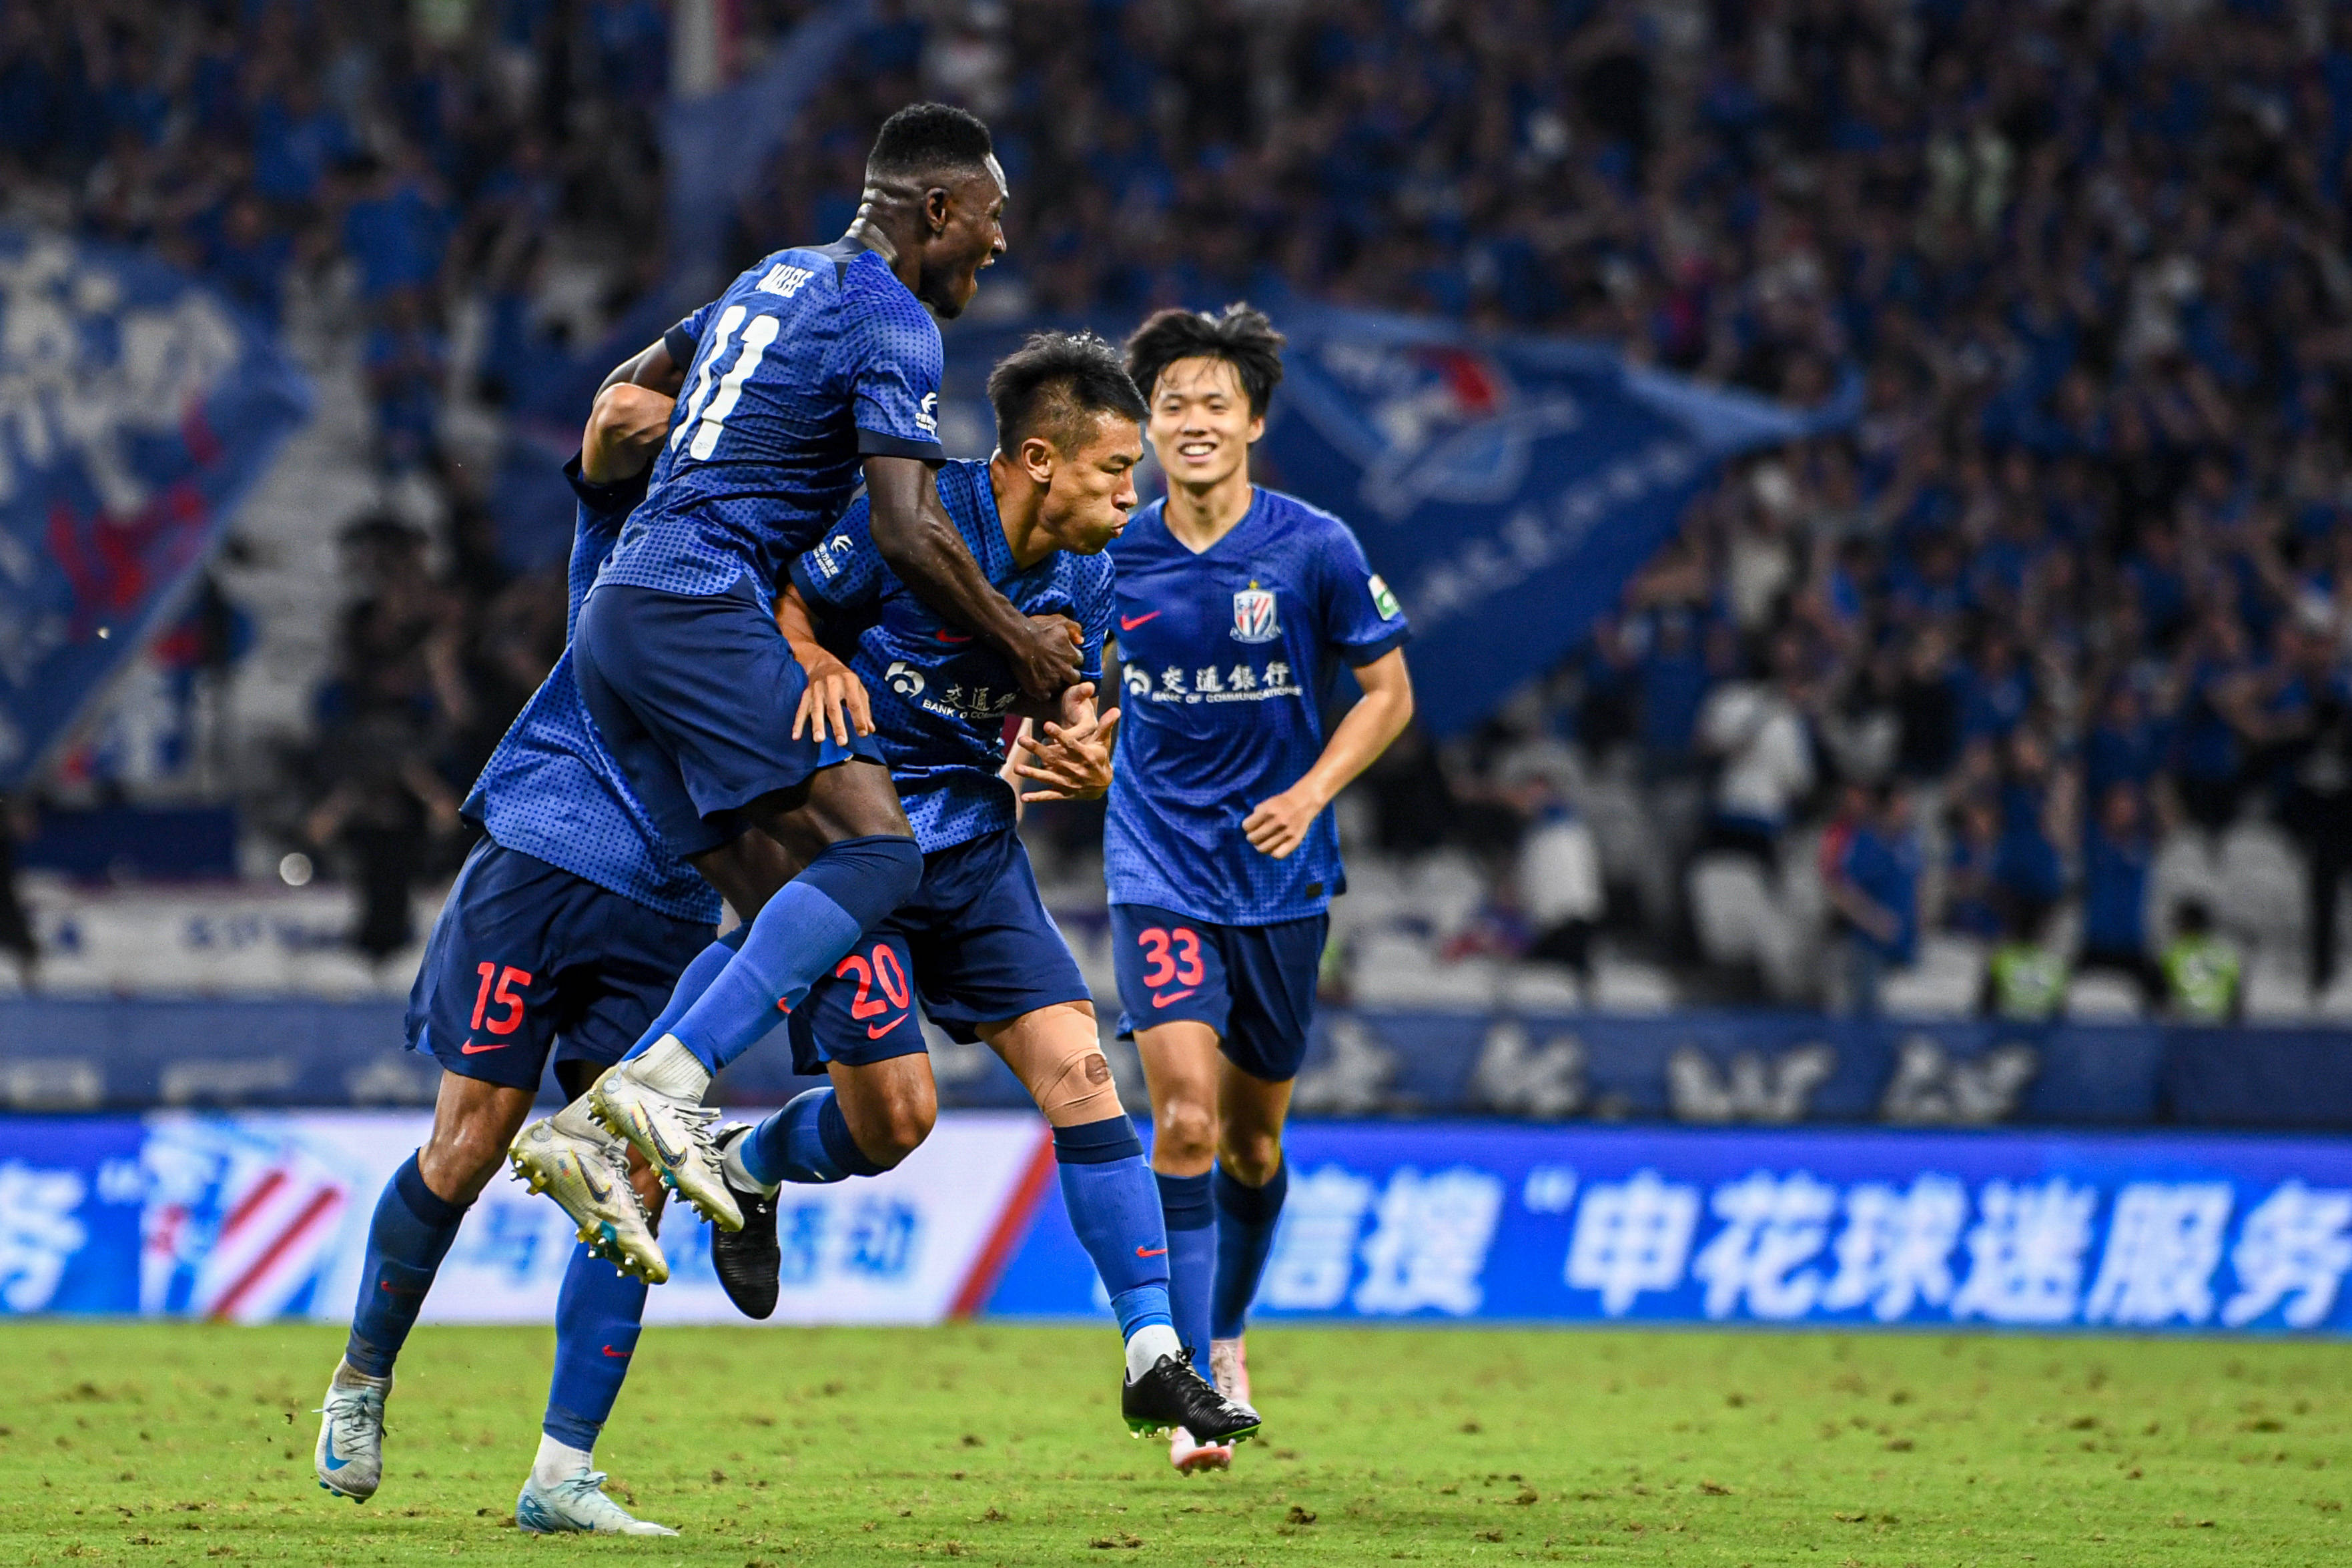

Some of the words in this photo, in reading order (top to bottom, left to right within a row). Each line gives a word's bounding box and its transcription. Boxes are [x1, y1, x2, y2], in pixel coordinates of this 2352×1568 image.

[670, 305, 779, 460] 11
[922, 699, 955, 718] BANK
[1152, 691, 1182, 703] BANK
[1185, 693, 1202, 704] OF
[1206, 685, 1303, 703] COMMUNICATIONS
[836, 943, 909, 1020] 20
[1138, 927, 1204, 988] 33
[470, 961, 532, 1036] 15
